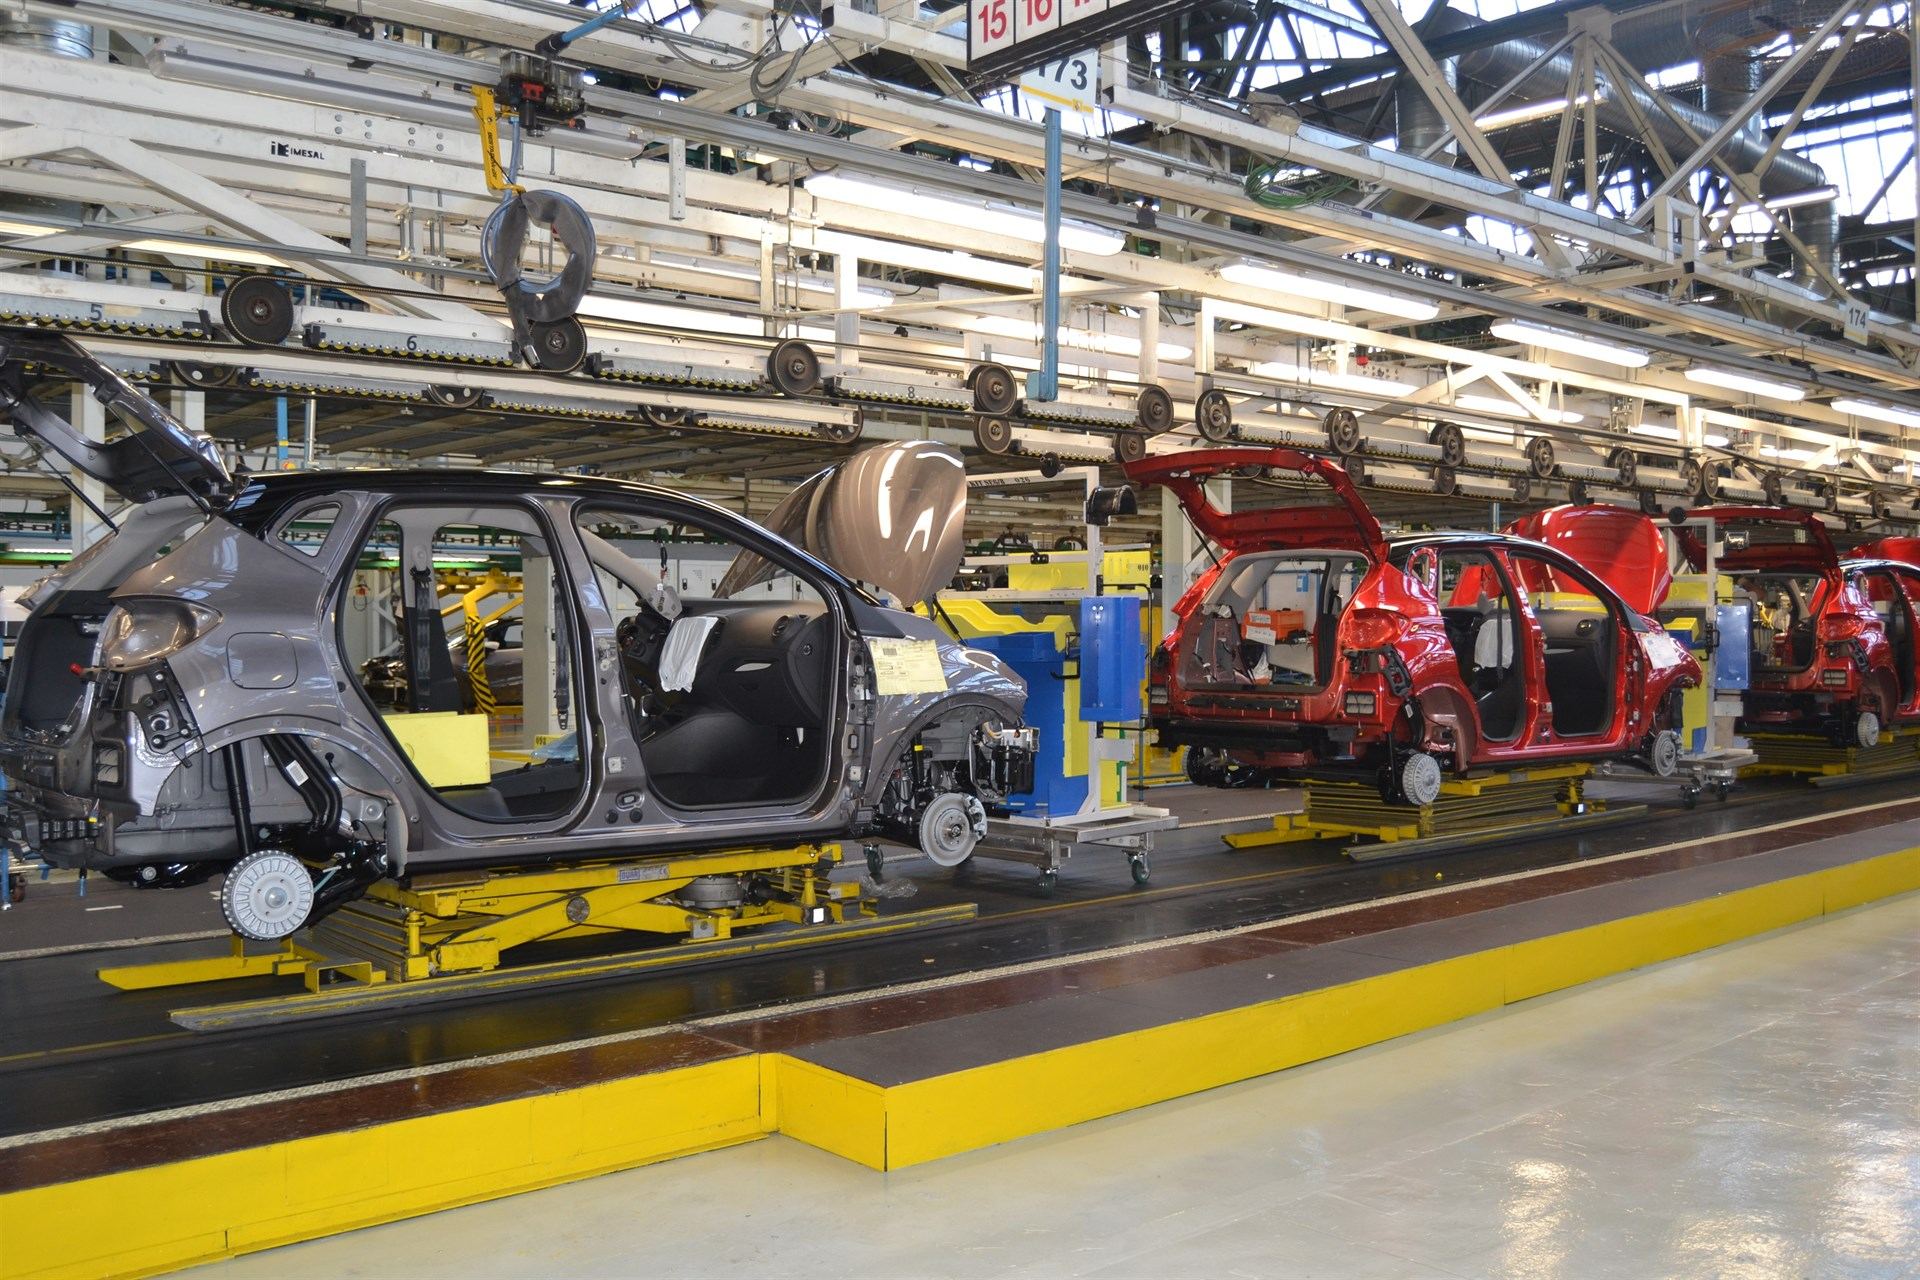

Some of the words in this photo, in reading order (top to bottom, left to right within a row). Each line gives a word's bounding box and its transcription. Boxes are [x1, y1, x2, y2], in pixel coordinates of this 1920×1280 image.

[978, 0, 1007, 43] 15
[290, 147, 325, 160] IMESAL
[90, 303, 103, 321] 5
[1849, 307, 1866, 328] 174
[406, 335, 418, 351] 6
[685, 365, 694, 379] 7
[908, 386, 915, 399] 8
[1279, 430, 1292, 441] 10
[1400, 443, 1409, 454] 11
